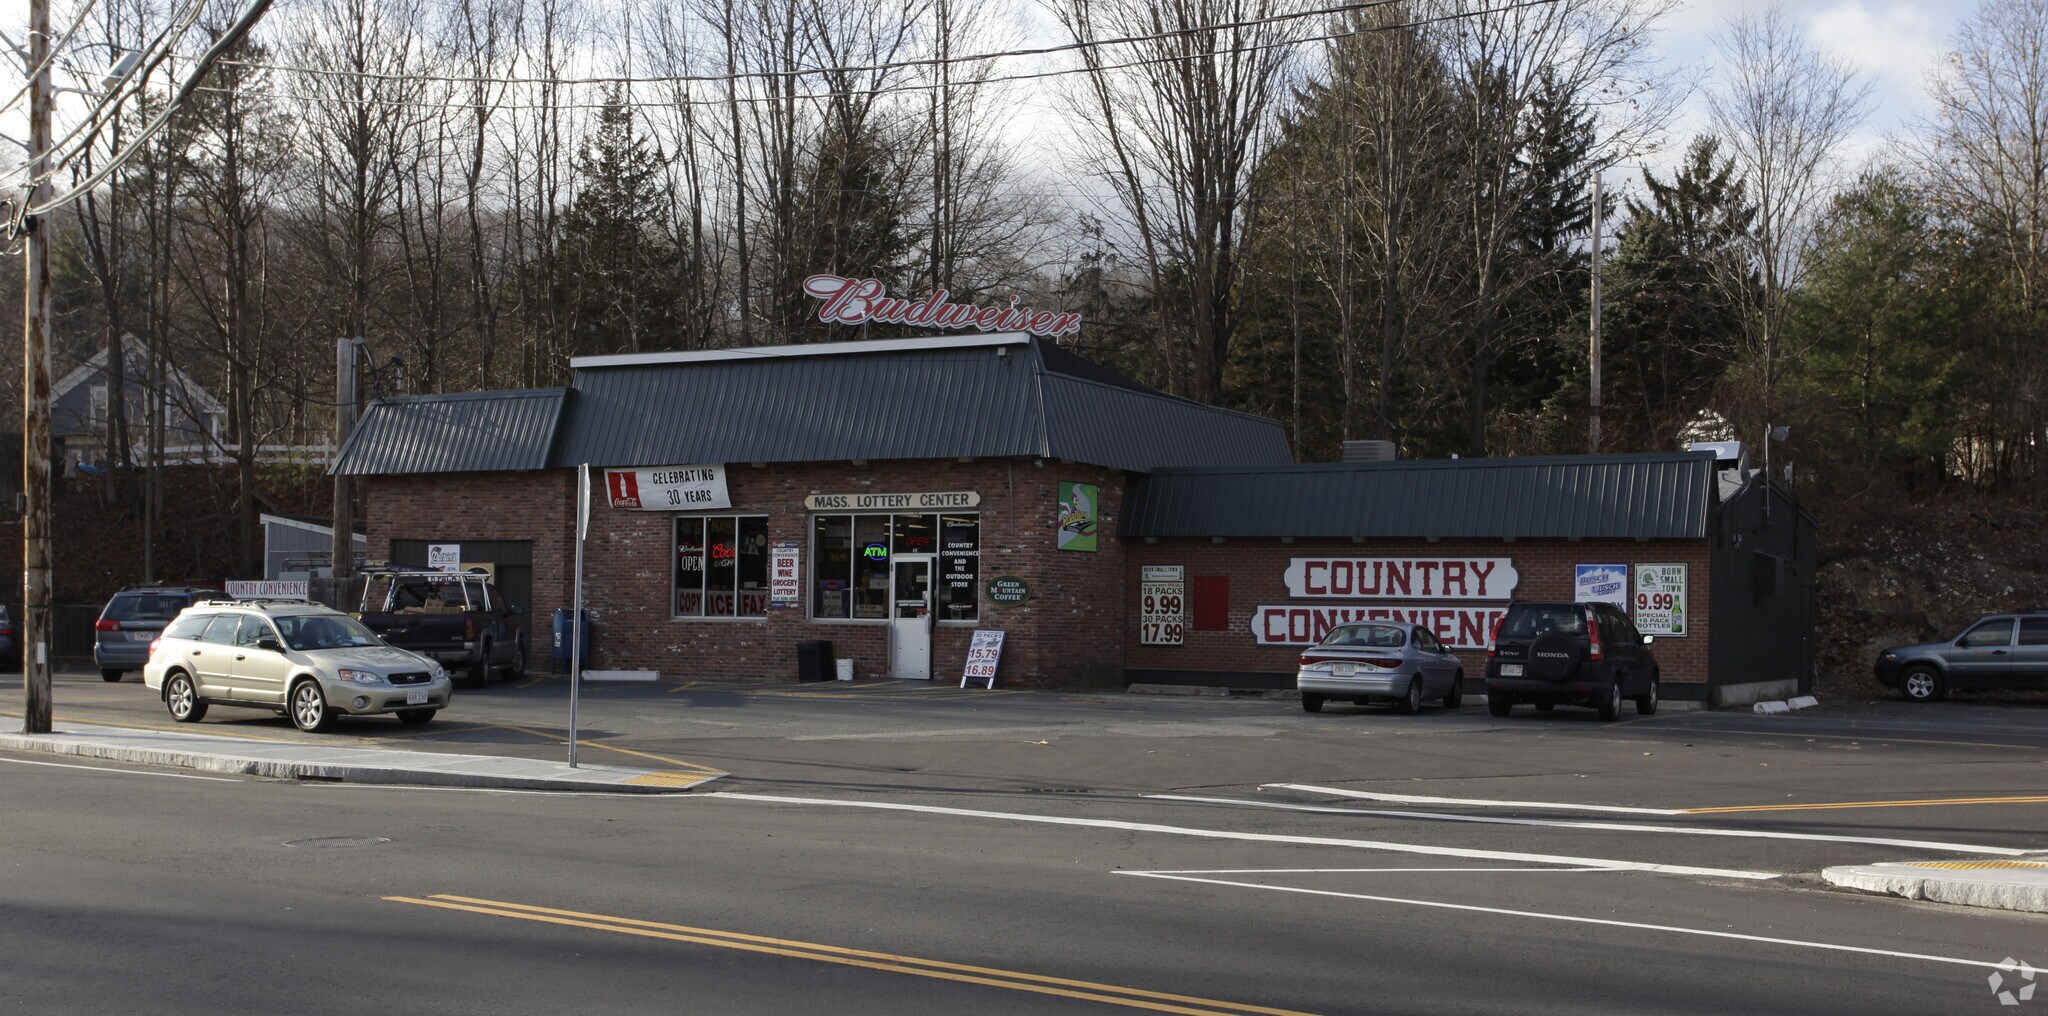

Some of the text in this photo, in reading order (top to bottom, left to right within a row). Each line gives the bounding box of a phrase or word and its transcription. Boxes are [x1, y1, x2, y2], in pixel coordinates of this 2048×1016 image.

[803, 275, 1081, 336] Budweiser
[653, 469, 714, 484] CELEBRATING
[667, 489, 712, 505] 30 YEARS
[814, 494, 969, 508] MASS. LOTTERY CENTER
[863, 546, 887, 557] ATM
[777, 559, 794, 568] BEER
[778, 569, 793, 577] WINE
[1304, 561, 1495, 595] COUNTRY
[1580, 573, 1609, 584] BUSCH
[773, 579, 798, 587] GROCERY
[1660, 576, 1683, 584] SMALL
[226, 582, 307, 595] COUNTRY CONVENIENCE
[1593, 582, 1619, 592] BUSCH
[680, 592, 703, 613] COPY
[709, 594, 735, 615] ICE
[742, 594, 767, 614] FAX
[1144, 595, 1181, 614] 9.99
[1637, 593, 1673, 610] 9.99
[1143, 615, 1183, 623] 30 PACKS
[1143, 623, 1182, 642] 17.99
[970, 649, 998, 659] 15.79
[966, 665, 994, 675] 16.89
